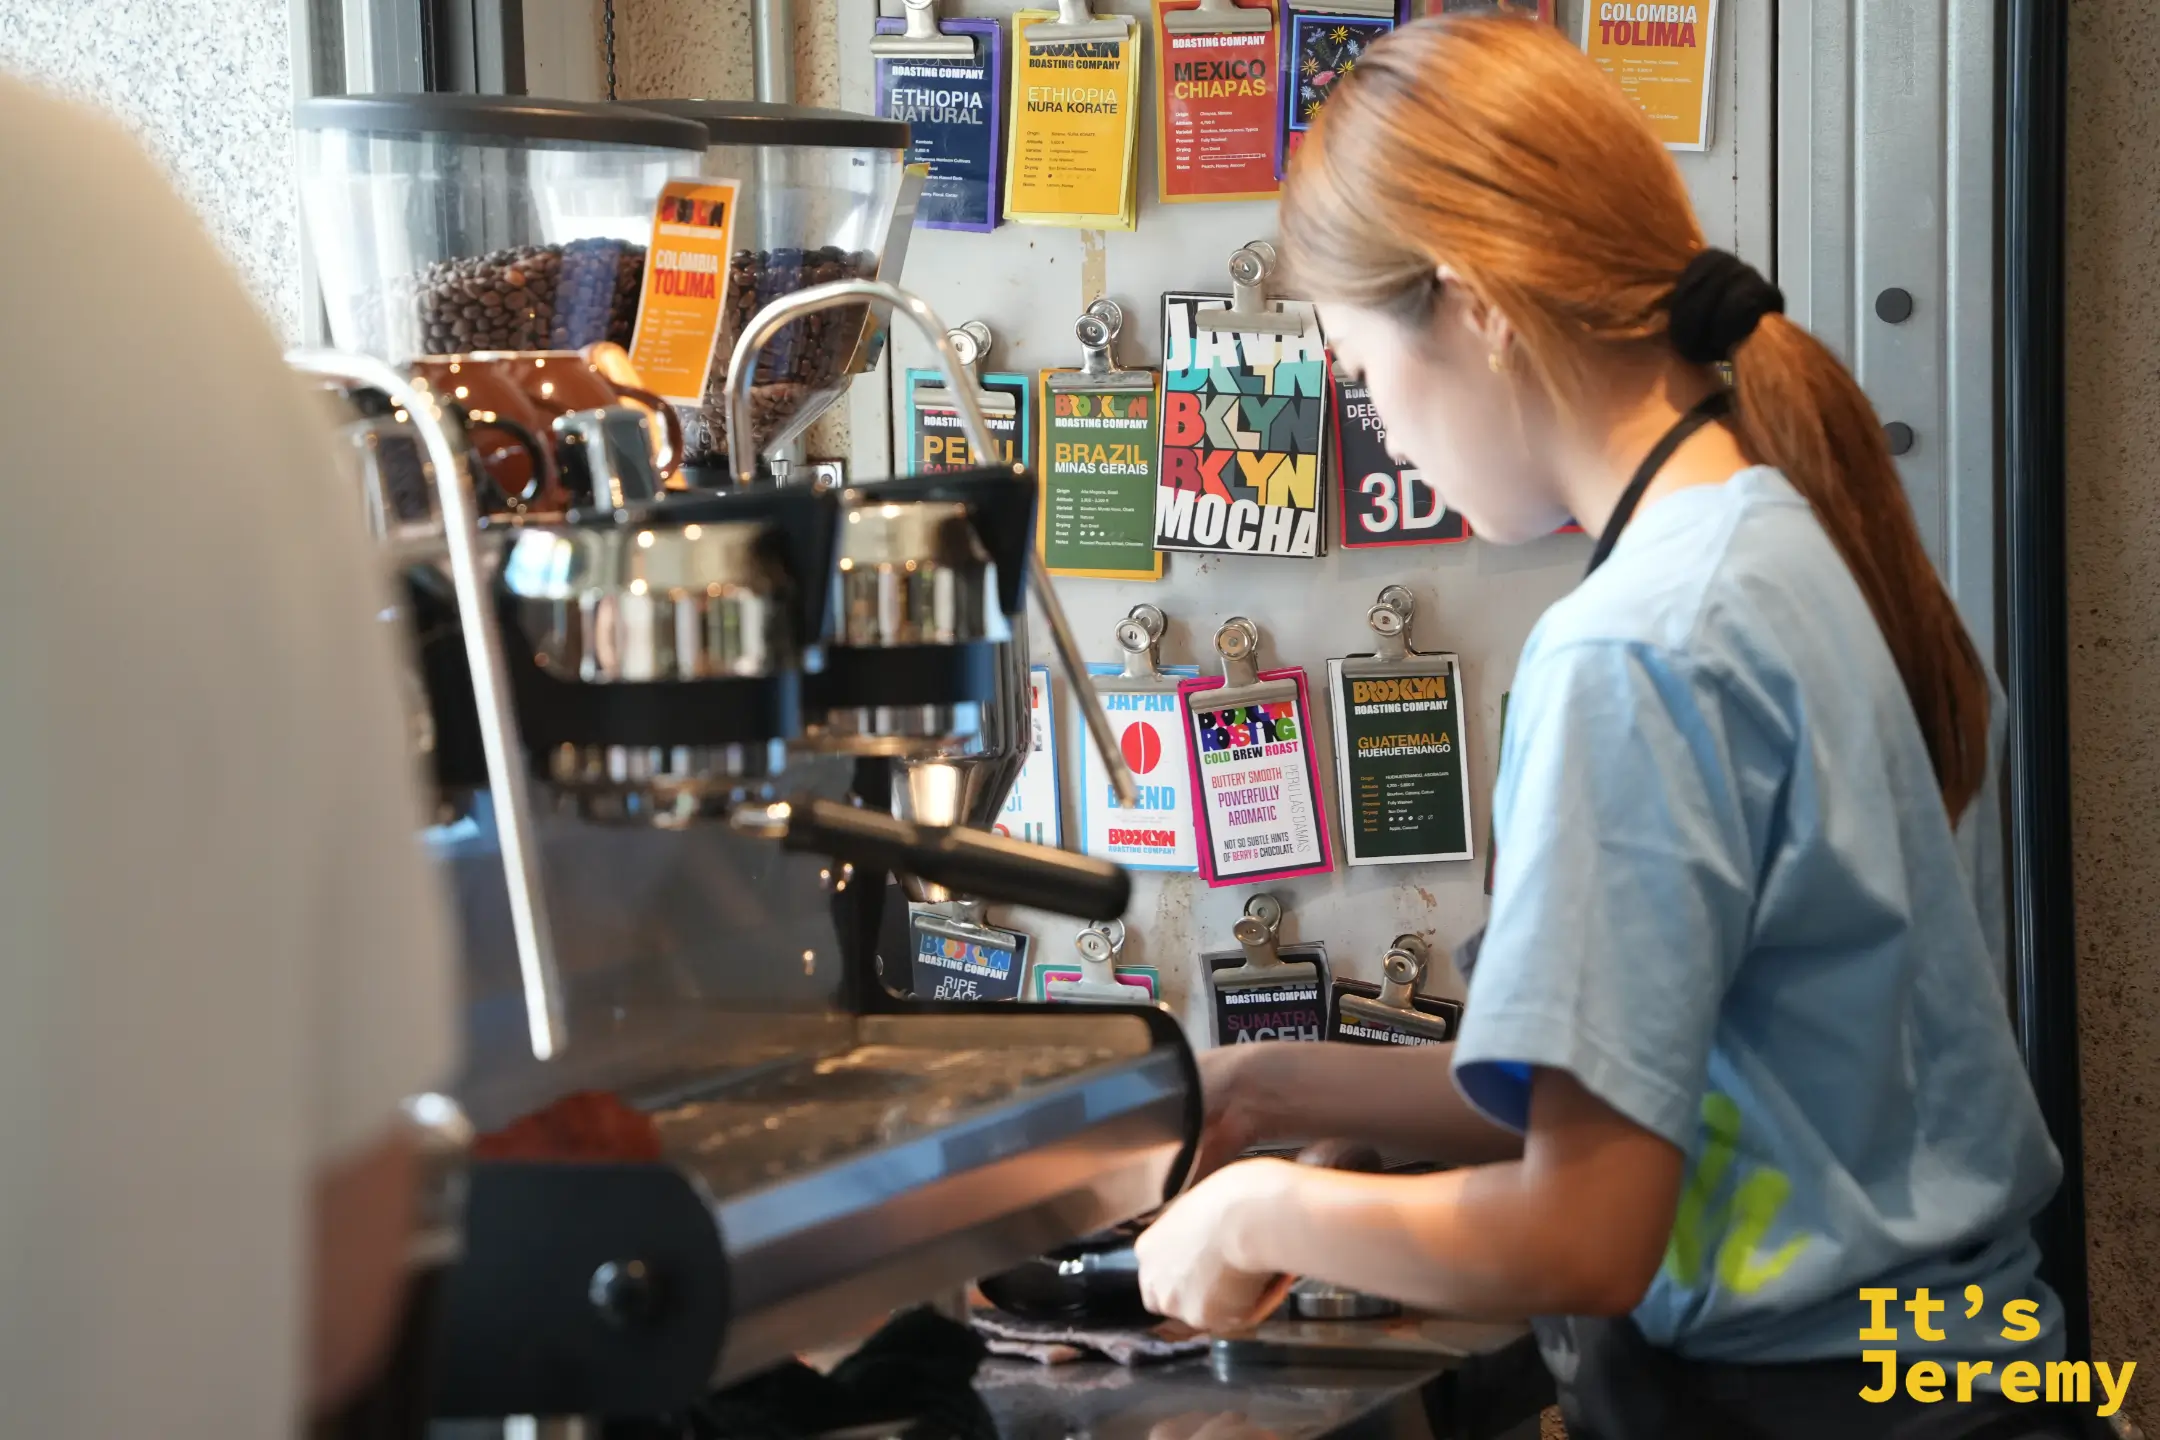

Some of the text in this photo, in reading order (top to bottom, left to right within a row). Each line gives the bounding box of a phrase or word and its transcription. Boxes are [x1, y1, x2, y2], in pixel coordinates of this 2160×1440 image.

[1600, 2, 1697, 24] COLOMBIA
[1172, 35, 1266, 49] ROASTING COMPANY
[1599, 20, 1697, 47] TOLIMA
[892, 65, 984, 80] ROASTING COMPANY
[1029, 59, 1120, 70] ROASTING COMPANY
[1174, 59, 1266, 82] MEXICO
[891, 88, 983, 109] ETHIOPIA
[1028, 86, 1117, 103] ETHIOPIA
[1174, 79, 1267, 100] CHIAPAS
[891, 105, 983, 125] NATURAL
[1027, 102, 1118, 114] NURA KORATE
[654, 268, 716, 299] TOLIMA
[1346, 403, 1377, 418] DEE
[1055, 417, 1148, 429] ROASTING COMPANY
[1164, 391, 1321, 453] BKLYN
[1055, 443, 1148, 464] BRAZIL
[1054, 461, 1148, 475] MINAS GERAIS
[1160, 446, 1317, 509] BKLYN
[1359, 469, 1447, 533] 3D
[1154, 485, 1318, 557] MOCHA
[1352, 676, 1446, 704] BROOKLYN
[1106, 694, 1175, 712] JAPAN
[1354, 700, 1448, 716] ROASTING COMPANY
[1357, 731, 1451, 749] GUATEMALA
[1204, 741, 1298, 765] COLD BREW ROAST
[1358, 743, 1451, 758] HUEHUETENANGO
[1212, 767, 1282, 789] BUTTERY SMOOTH
[1107, 783, 1176, 811] BEND
[1218, 784, 1280, 808] POWERFULLY
[1228, 805, 1277, 827] AROMATIC
[1284, 763, 1311, 853] PERU LAS DAMAS
[1108, 828, 1176, 847] BROOKLYN
[1224, 831, 1289, 850] NOT SO SUBTLE HINTS
[1108, 845, 1176, 855] ROASTING COMPANY
[1223, 852, 1231, 863] OF
[1232, 849, 1252, 862] BERRY
[1260, 843, 1294, 858] CHOCOLATE
[918, 953, 1009, 981] ROASTING COMPANY
[935, 985, 983, 1000] BLACK
[943, 975, 978, 994] RIPE
[1225, 990, 1318, 1005] ROASTING COMPANY
[1227, 1010, 1320, 1030] SUMATRA
[1339, 1023, 1389, 1042] ROASTING
